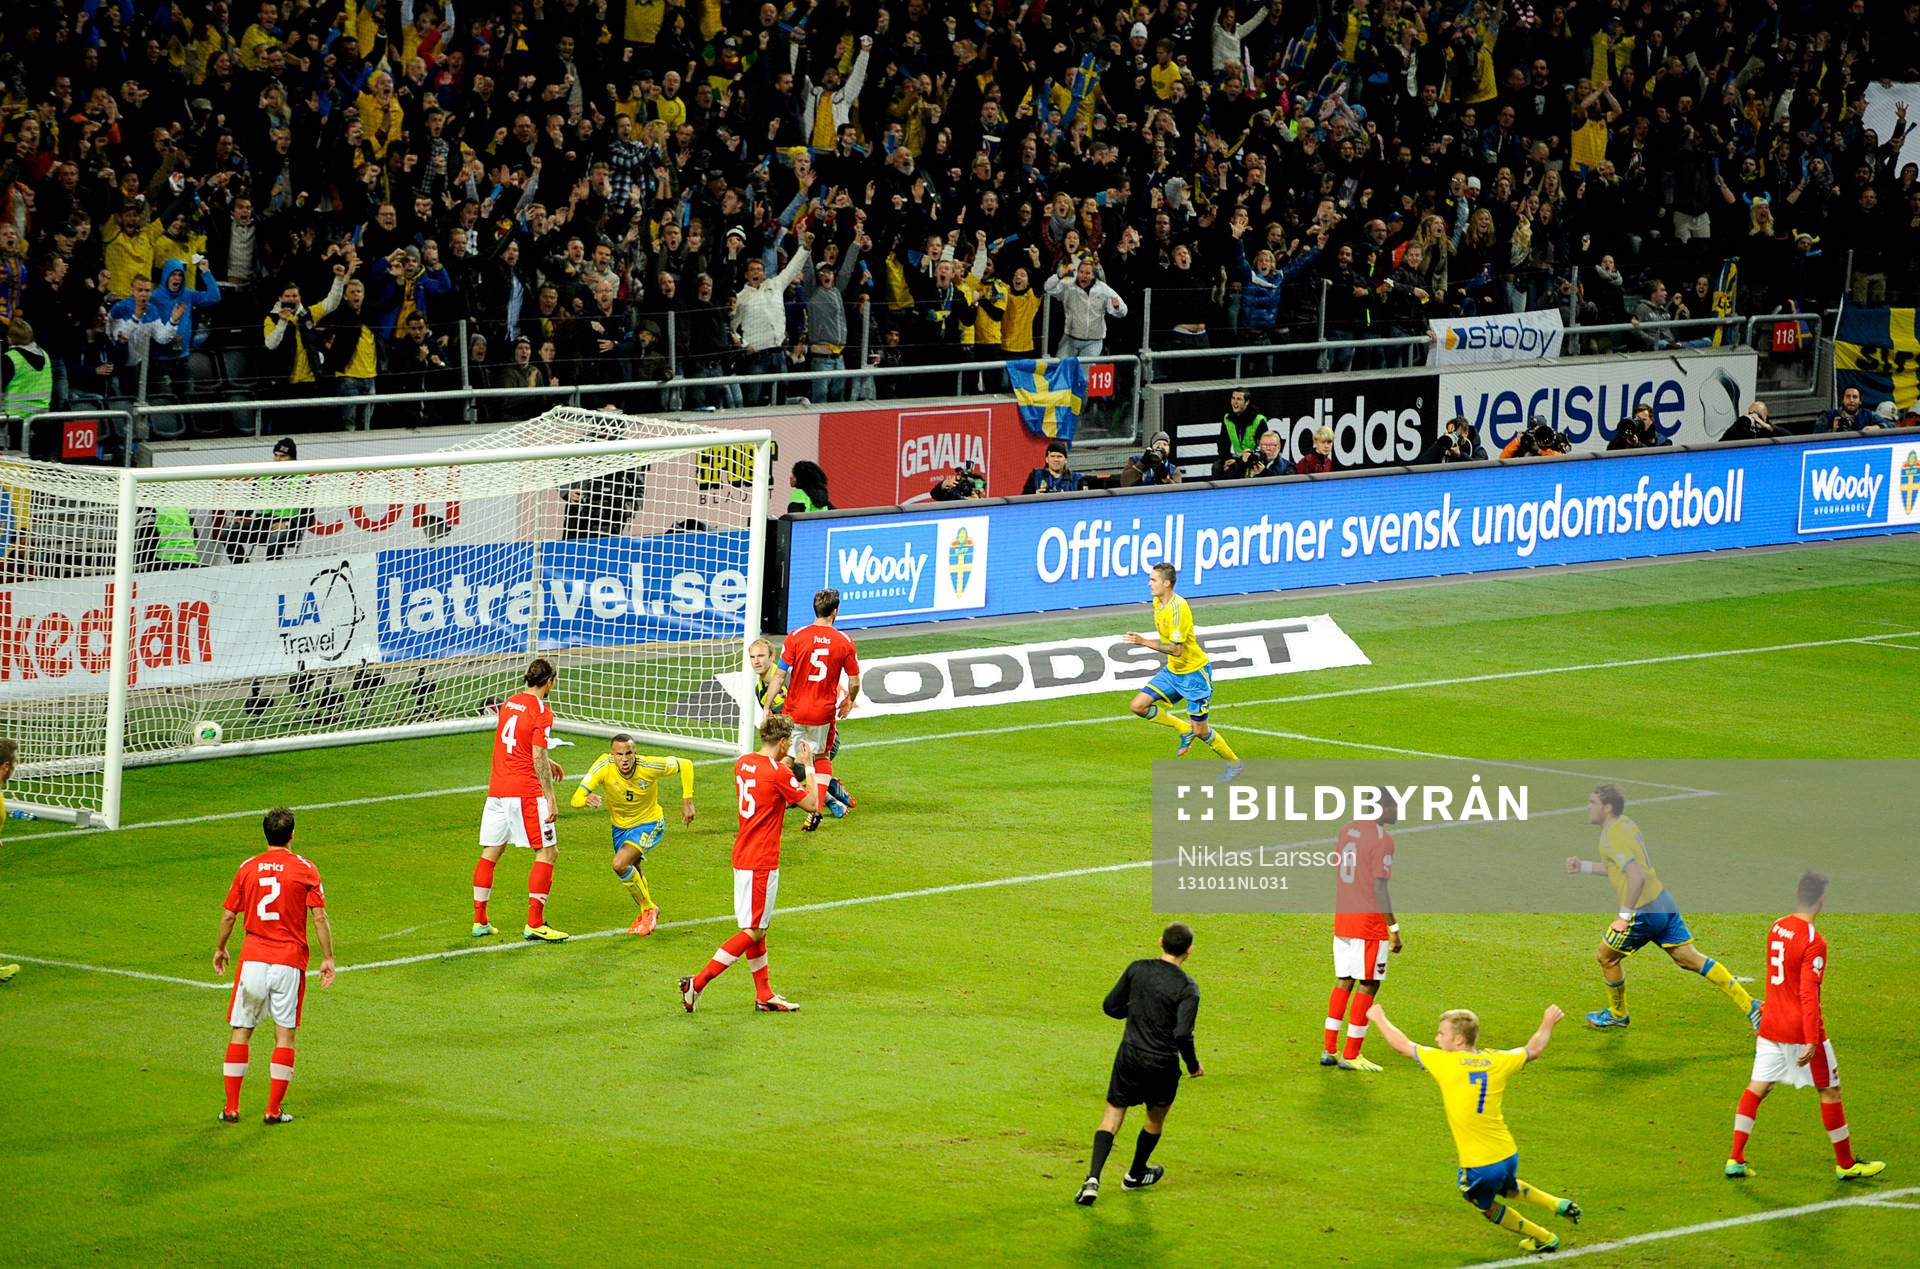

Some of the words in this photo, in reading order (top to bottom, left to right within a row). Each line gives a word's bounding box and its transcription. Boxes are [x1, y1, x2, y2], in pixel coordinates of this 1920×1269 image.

[1468, 318, 1556, 358] stoby
[1776, 328, 1794, 345] 118
[1092, 371, 1112, 389] 119
[66, 429, 94, 449] 120
[901, 432, 986, 478] GEVALIA
[1811, 463, 1884, 518] Woody
[1036, 514, 1185, 583] Officiell
[1194, 513, 1334, 585] partner
[1341, 492, 1462, 558] svensk
[1472, 468, 1744, 556] ungdomsfotboll
[838, 541, 929, 604] Woody
[278, 592, 320, 627] LA
[388, 562, 747, 633] latravel.se
[280, 628, 334, 655] Travel
[808, 648, 829, 682] 5
[861, 622, 1308, 704] ODDSET
[501, 714, 517, 754] 4
[626, 790, 634, 801] 5
[736, 775, 757, 819] 15
[640, 832, 648, 847] 5
[257, 876, 281, 921] 2
[1770, 941, 1785, 985] 3
[1468, 1071, 1488, 1114] 7
